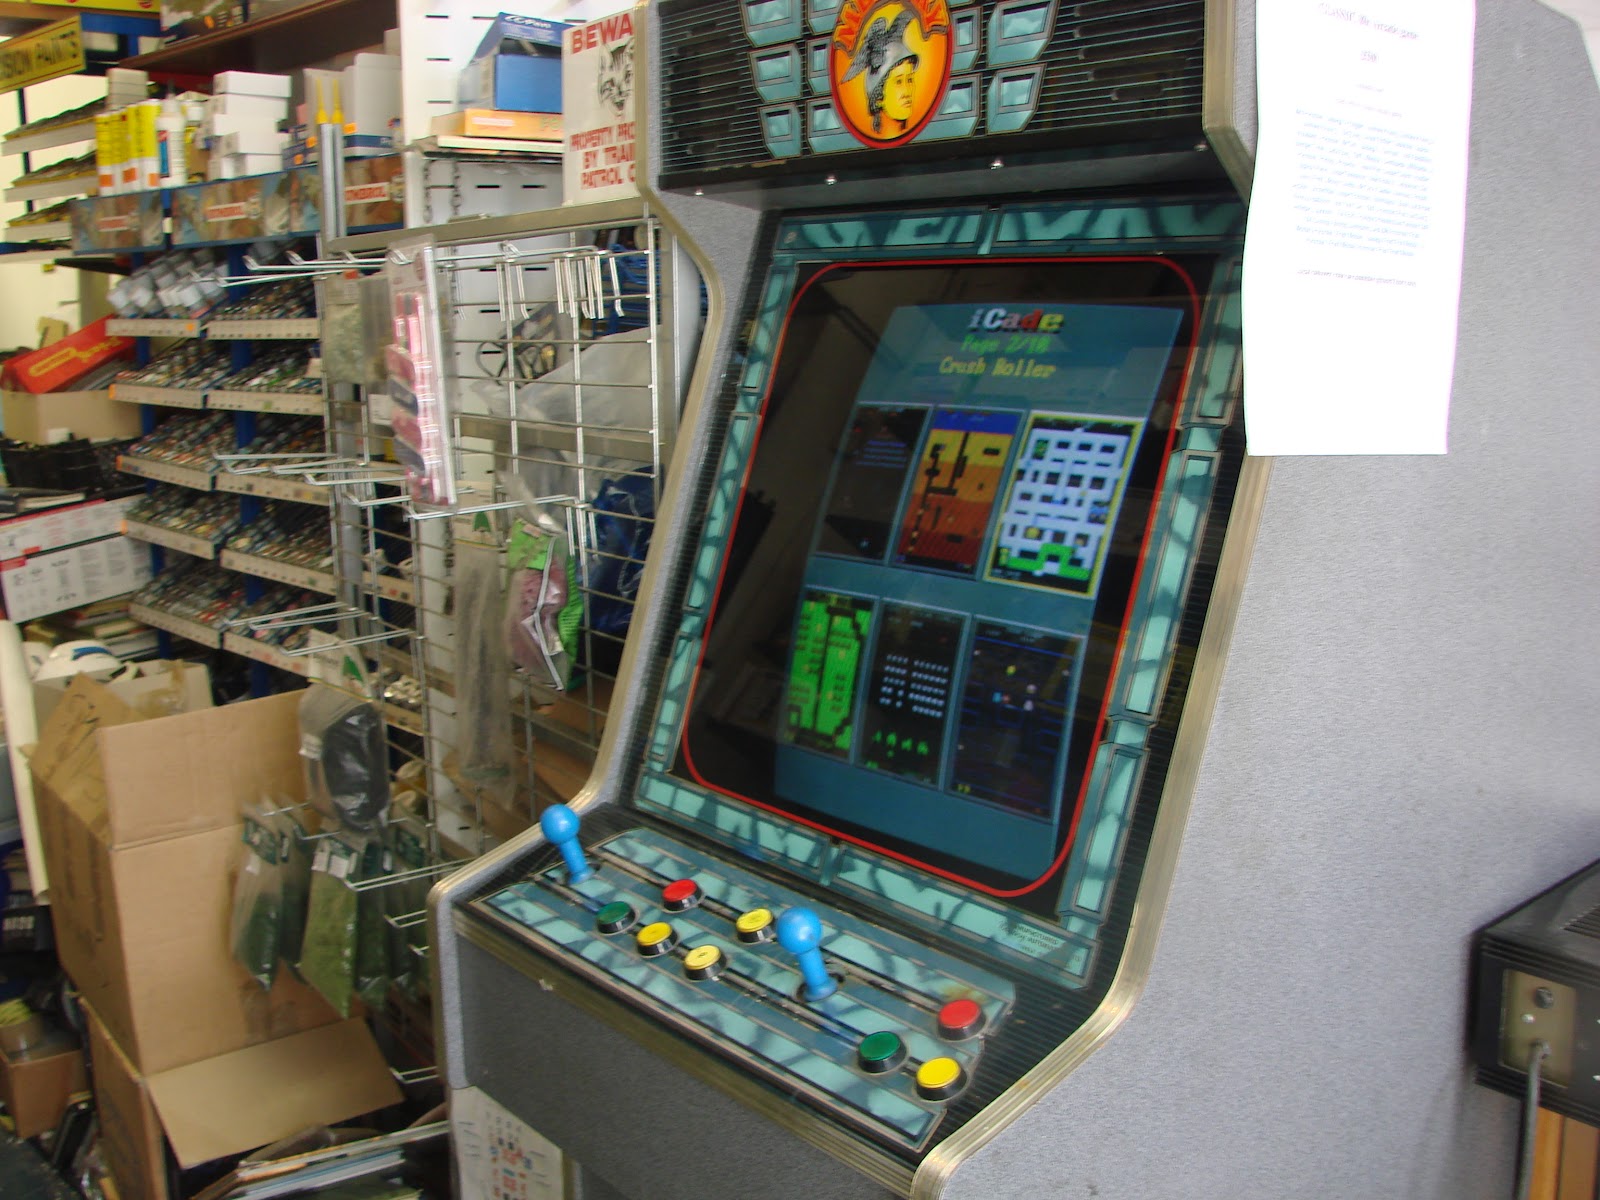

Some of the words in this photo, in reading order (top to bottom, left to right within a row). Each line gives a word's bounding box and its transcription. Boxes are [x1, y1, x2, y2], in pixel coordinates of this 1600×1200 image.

[583, 149, 599, 169] BY
[581, 166, 624, 191] PATROL
[967, 307, 1064, 333] iCade
[991, 357, 1057, 379] Roller
